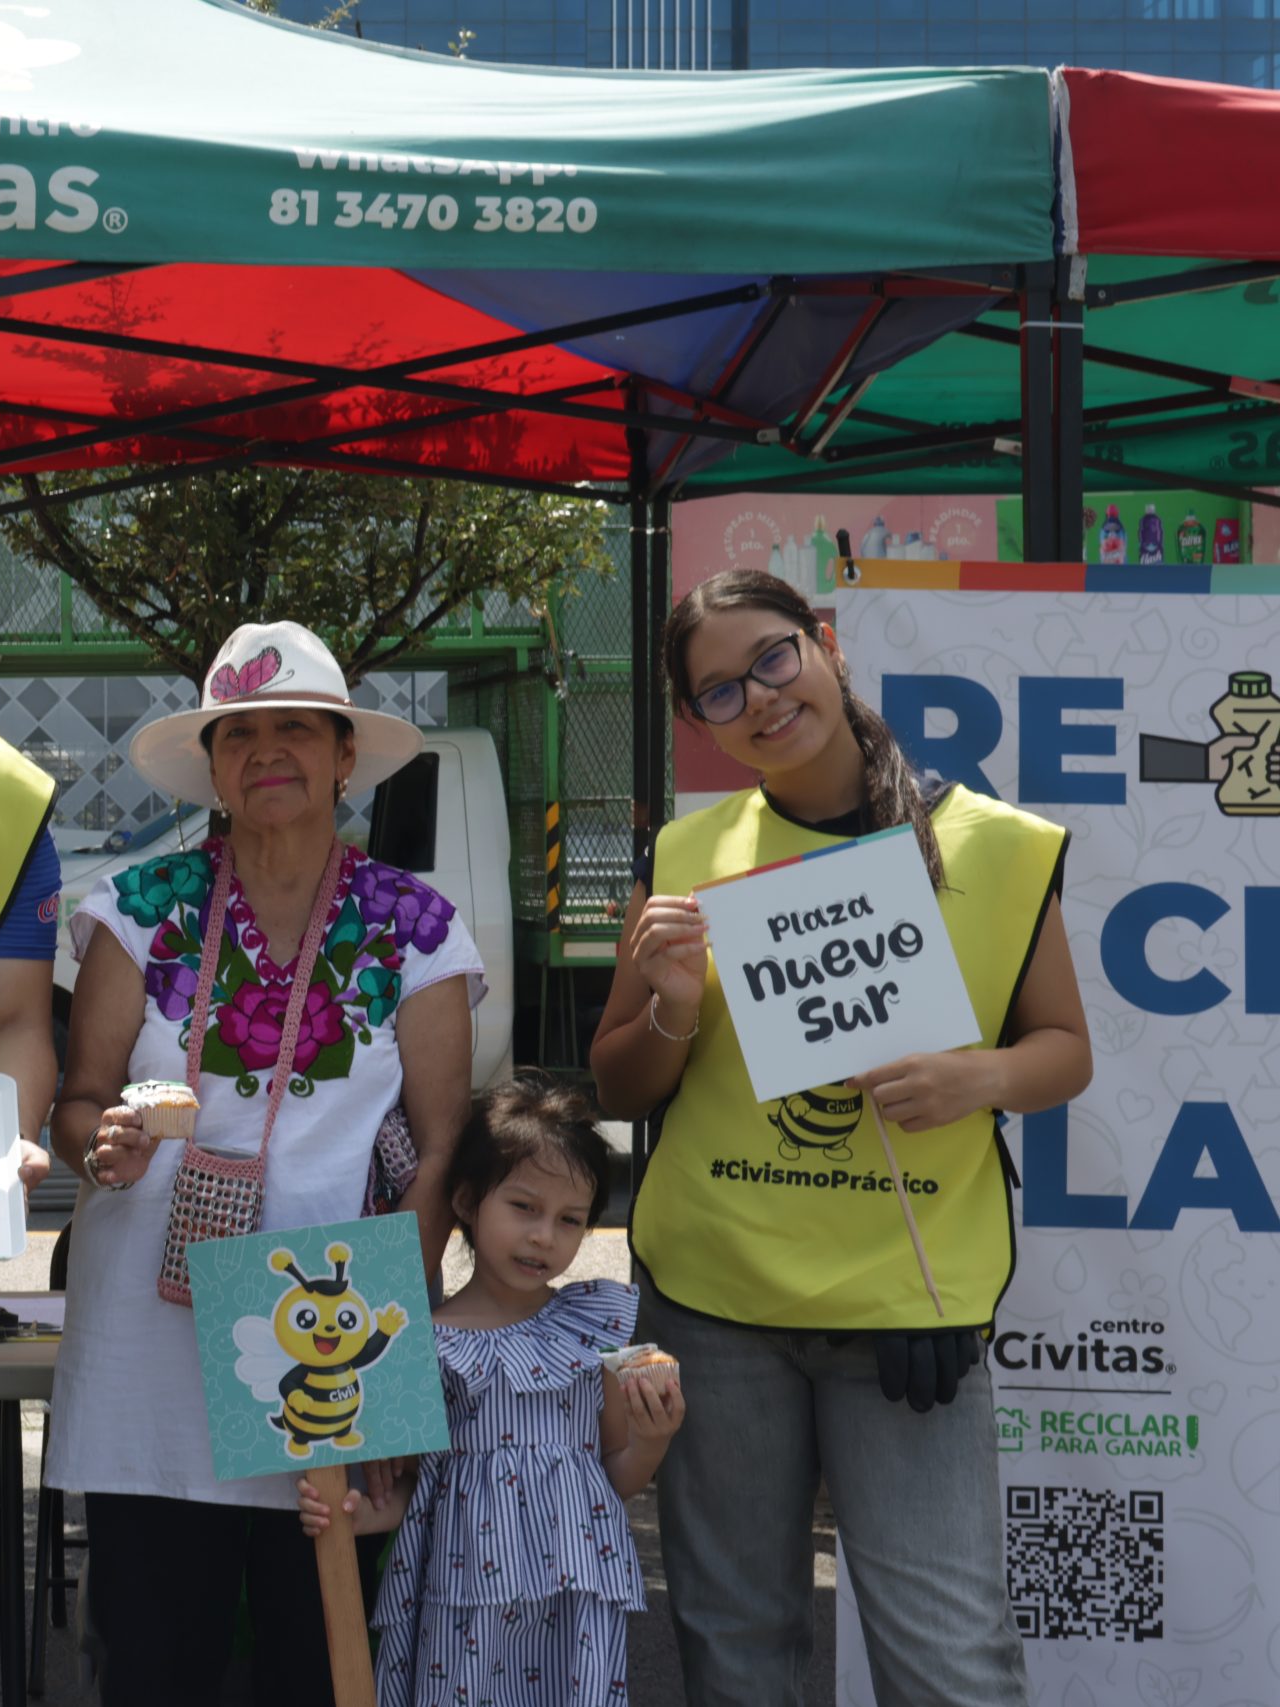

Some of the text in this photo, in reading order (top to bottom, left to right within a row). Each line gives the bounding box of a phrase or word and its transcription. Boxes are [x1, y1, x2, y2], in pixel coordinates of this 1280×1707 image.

[269, 188, 597, 233] 81 3470 3820
[881, 673, 1127, 805] RE
[1100, 882, 1280, 1016] CI
[997, 1101, 1280, 1233] LA
[1090, 1319, 1165, 1335] centro
[1040, 1410, 1181, 1438] RECICLAR
[1041, 1436, 1182, 1457] PARA GANAR
